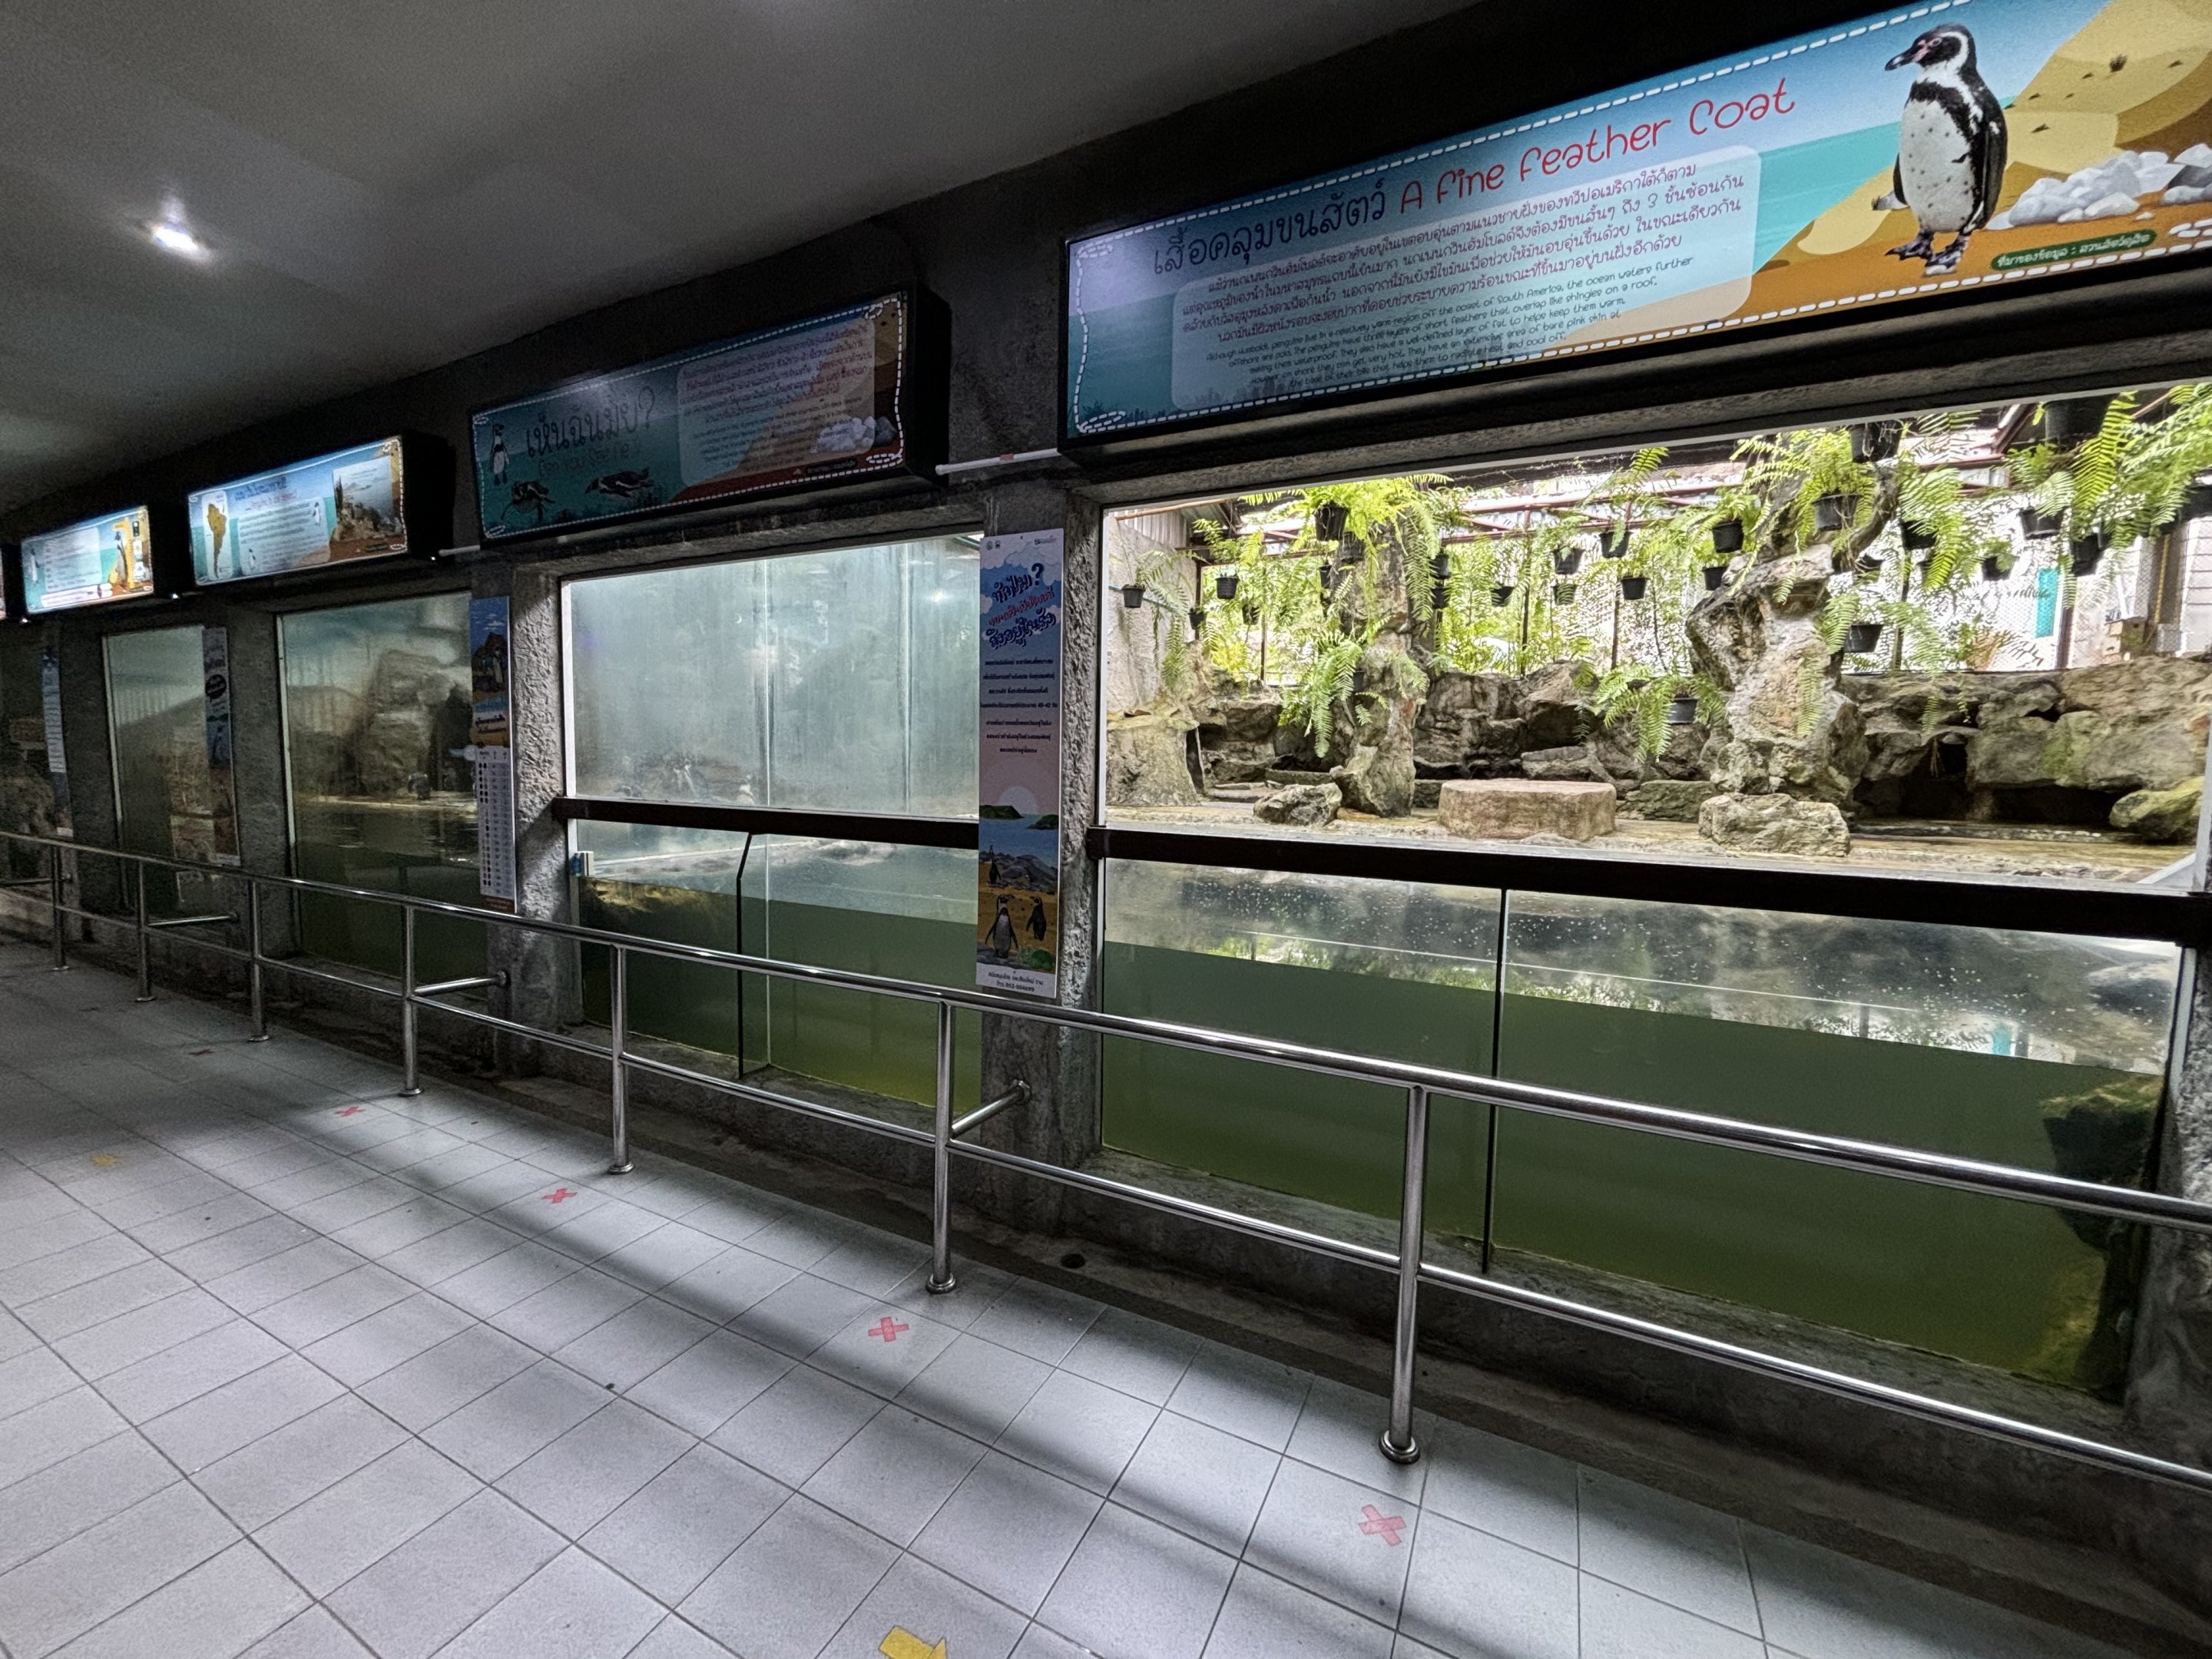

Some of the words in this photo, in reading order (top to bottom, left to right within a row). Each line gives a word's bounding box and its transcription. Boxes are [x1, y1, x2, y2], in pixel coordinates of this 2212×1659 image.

[1400, 177, 1422, 214] A
[1689, 75, 1795, 137] Coat
[1622, 195, 1640, 214] ถึง
[1648, 192, 1658, 208] 3
[1664, 168, 1743, 204] ชั้นซ้อนกัน
[1635, 194, 1740, 233] ในขณะเดียวกัน
[1154, 177, 1385, 276] เสื้อคลุมขนสัตว์
[1343, 335, 1360, 345] have
[1412, 322, 1422, 332] of
[1425, 317, 1448, 329] short
[1451, 310, 1487, 324] feathers
[1490, 304, 1510, 316] that
[1512, 298, 1547, 315] overlap
[1548, 294, 1562, 305] like
[1566, 286, 1602, 304] shingles
[1604, 285, 1618, 294] on
[1621, 283, 1628, 291] a
[1422, 308, 1436, 319] off
[1439, 304, 1452, 315] the
[1455, 299, 1480, 312] coast
[1482, 296, 1494, 306] of
[1497, 290, 1524, 303] South
[1567, 277, 1583, 290] the
[1585, 273, 1615, 286] ocean
[1618, 264, 1652, 279] waters
[1655, 254, 1694, 272] further
[1369, 353, 1386, 365] very
[1408, 344, 1426, 359] They
[1428, 340, 1447, 352] have
[1450, 339, 1461, 348] an
[1463, 330, 1503, 346] extensive
[1506, 327, 1525, 338] area
[1528, 323, 1541, 334] of
[1543, 318, 1564, 331] bare
[1567, 315, 1585, 329] pink
[1588, 311, 1607, 323] skin
[1610, 309, 1621, 320] at
[1376, 338, 1396, 349] have
[1455, 323, 1476, 338] layer
[1479, 320, 1489, 331] of
[1492, 317, 1506, 328] fat
[1509, 314, 1521, 325] to
[1524, 310, 1547, 325] helps
[1548, 305, 1570, 320] keep
[1573, 300, 1596, 313] them
[1438, 351, 1449, 361] to
[1507, 338, 1523, 349] and
[1526, 334, 1545, 346] cool
